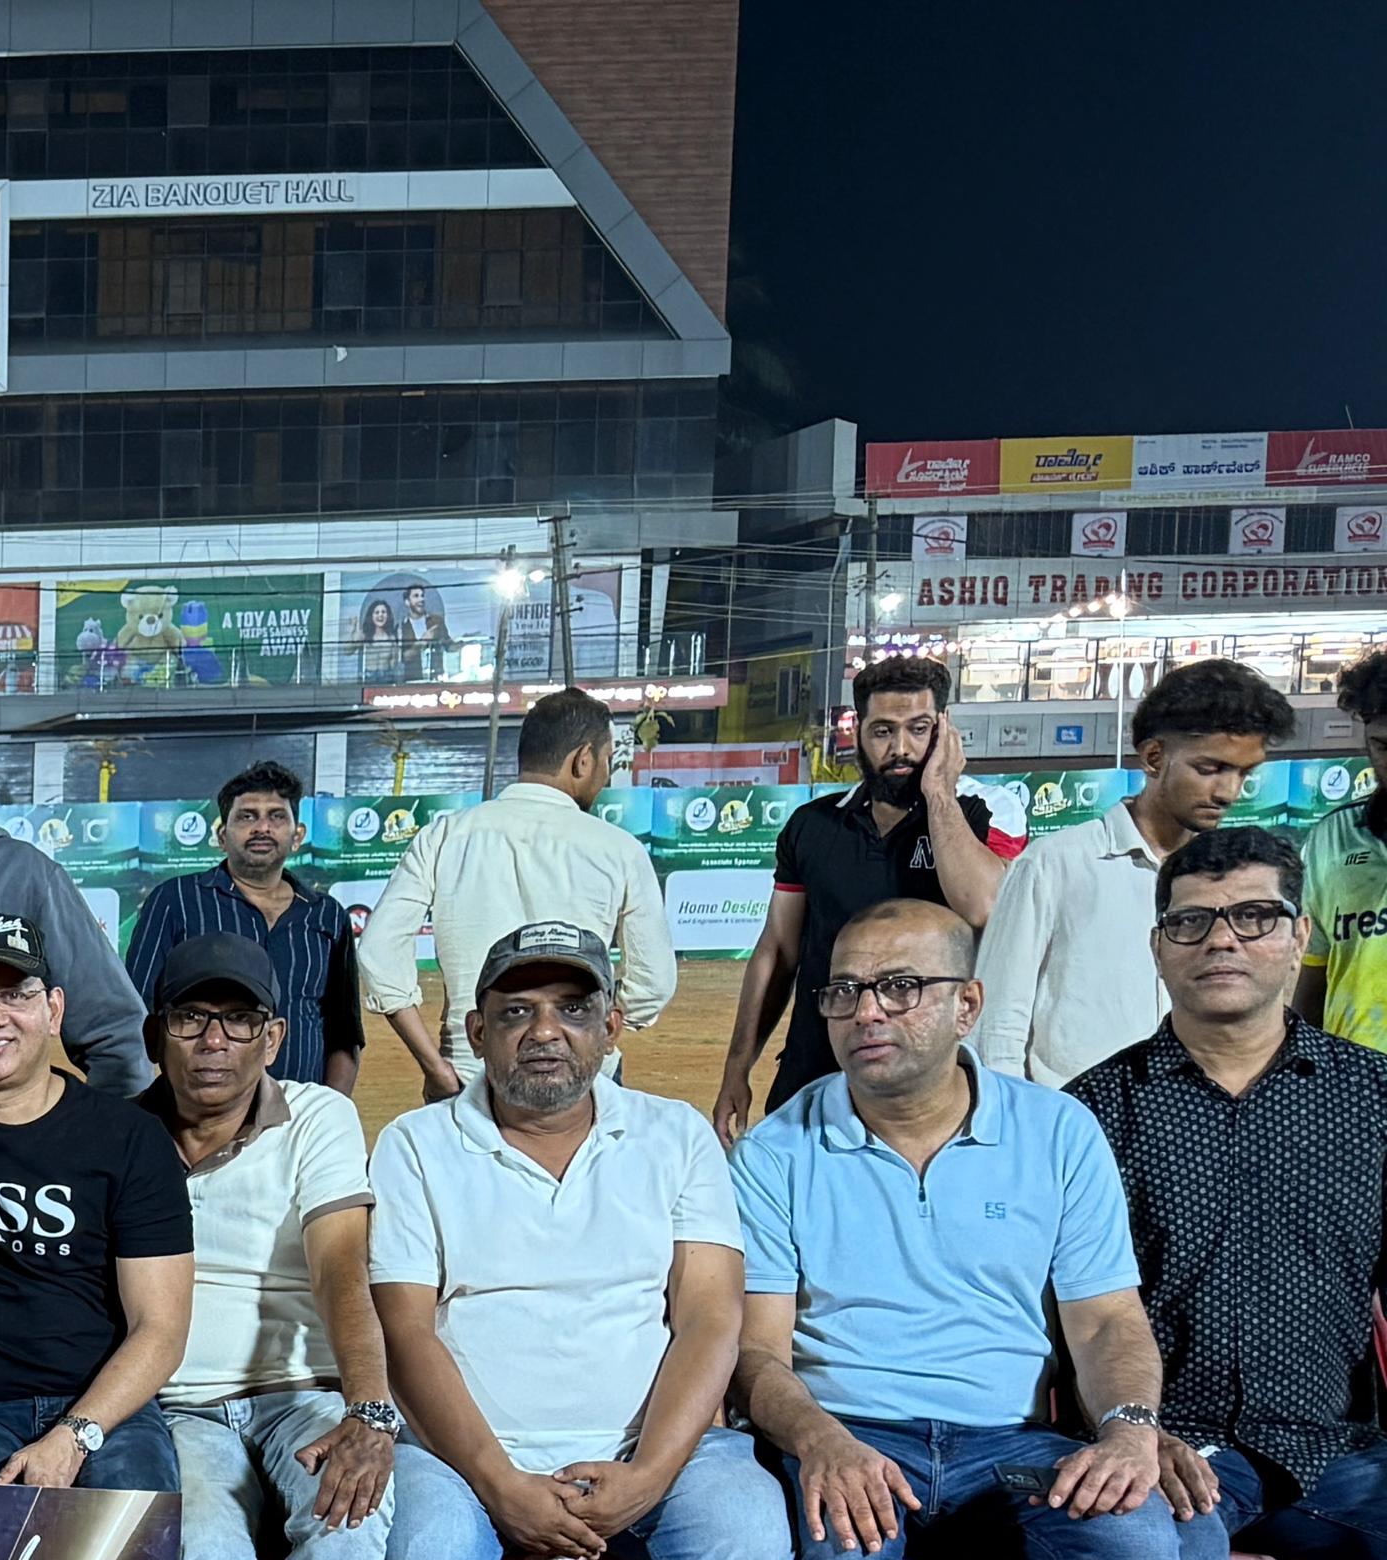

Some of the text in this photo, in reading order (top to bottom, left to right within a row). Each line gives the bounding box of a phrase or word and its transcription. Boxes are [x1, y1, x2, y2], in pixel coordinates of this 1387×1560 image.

[92, 179, 354, 208] ZIA BANQUET HALL
[1329, 453, 1371, 464] RAMCO
[918, 575, 1009, 606] ASHIQ
[236, 610, 264, 628] TOY
[280, 609, 311, 626] DAY
